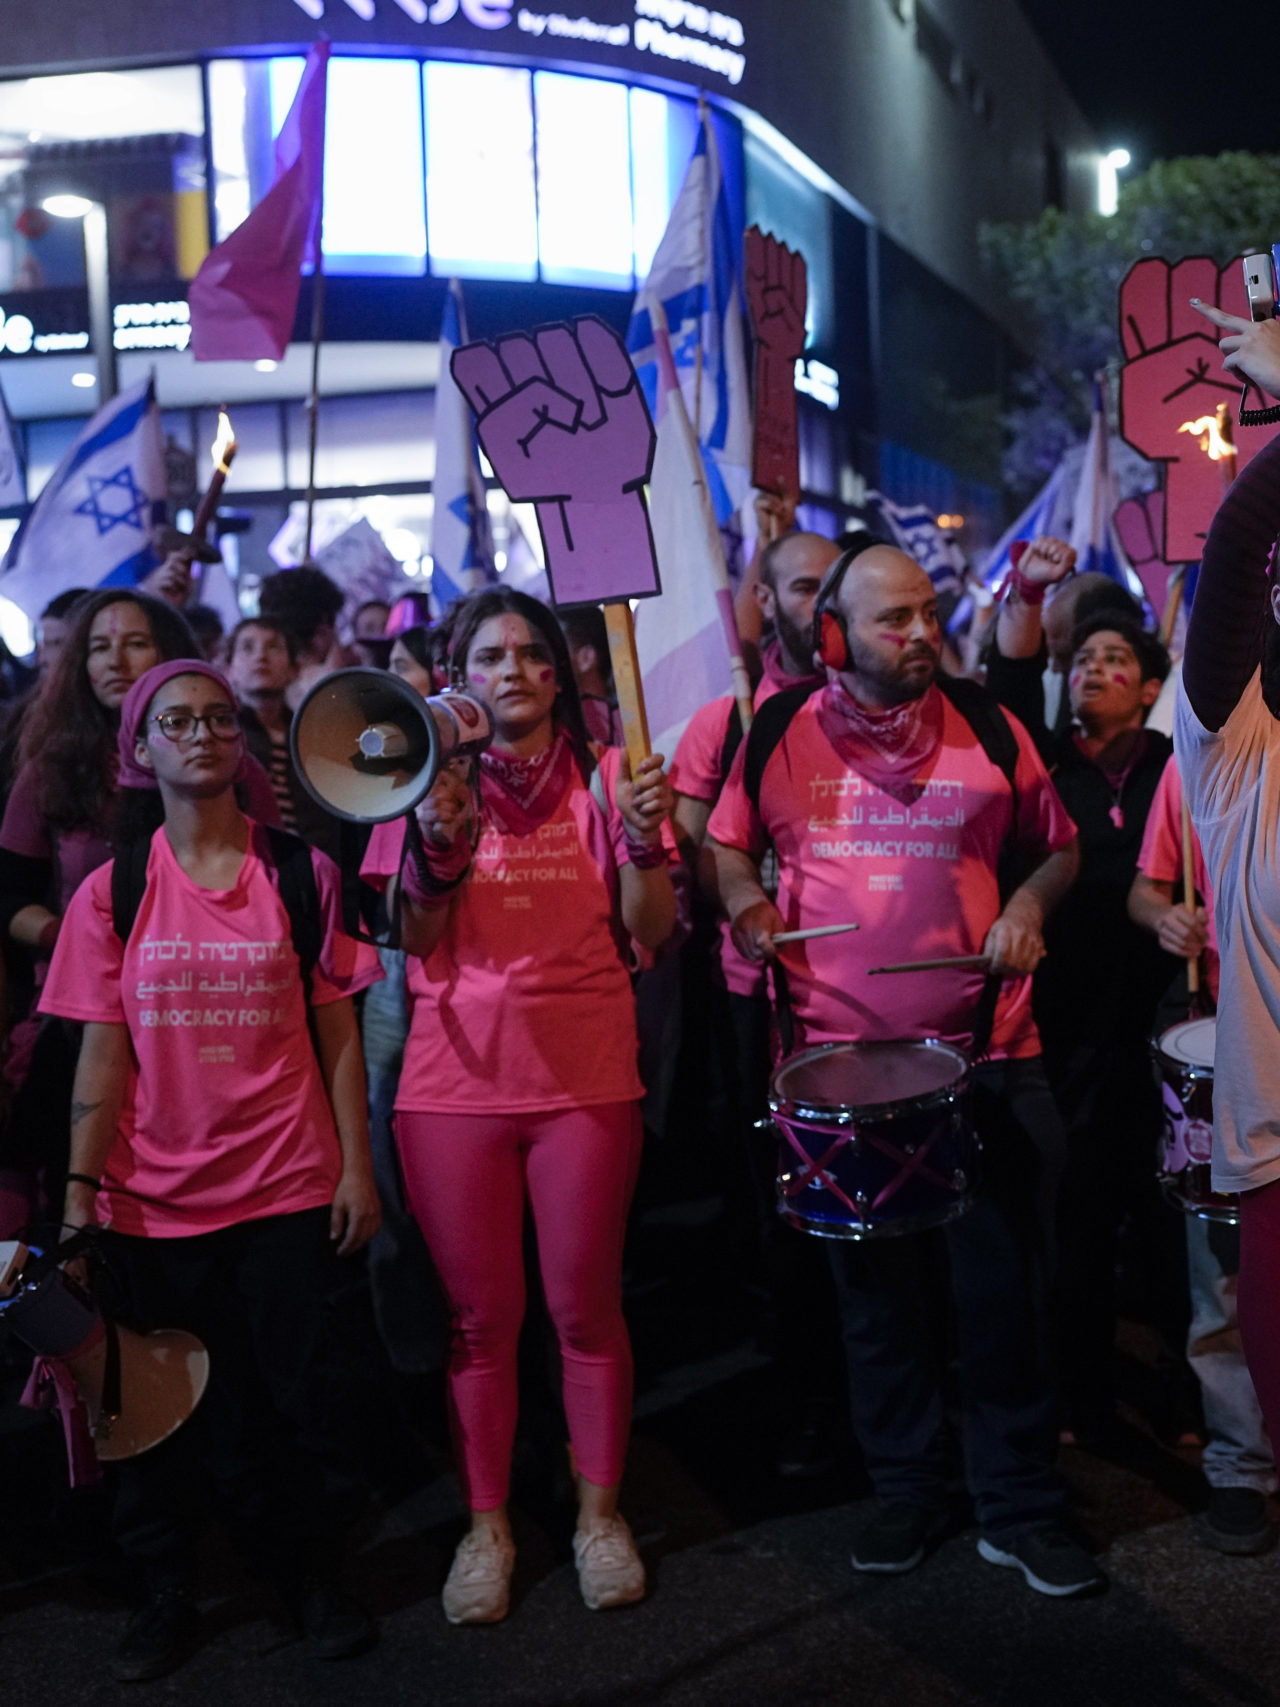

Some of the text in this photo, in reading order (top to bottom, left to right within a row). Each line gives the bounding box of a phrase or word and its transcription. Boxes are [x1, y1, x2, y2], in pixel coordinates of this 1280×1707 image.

[811, 840, 960, 860] DEMOCRACY FOR ALL
[532, 866, 557, 882] FOR
[139, 1008, 237, 1028] DEMOCRACY
[238, 1008, 271, 1027] FOR
